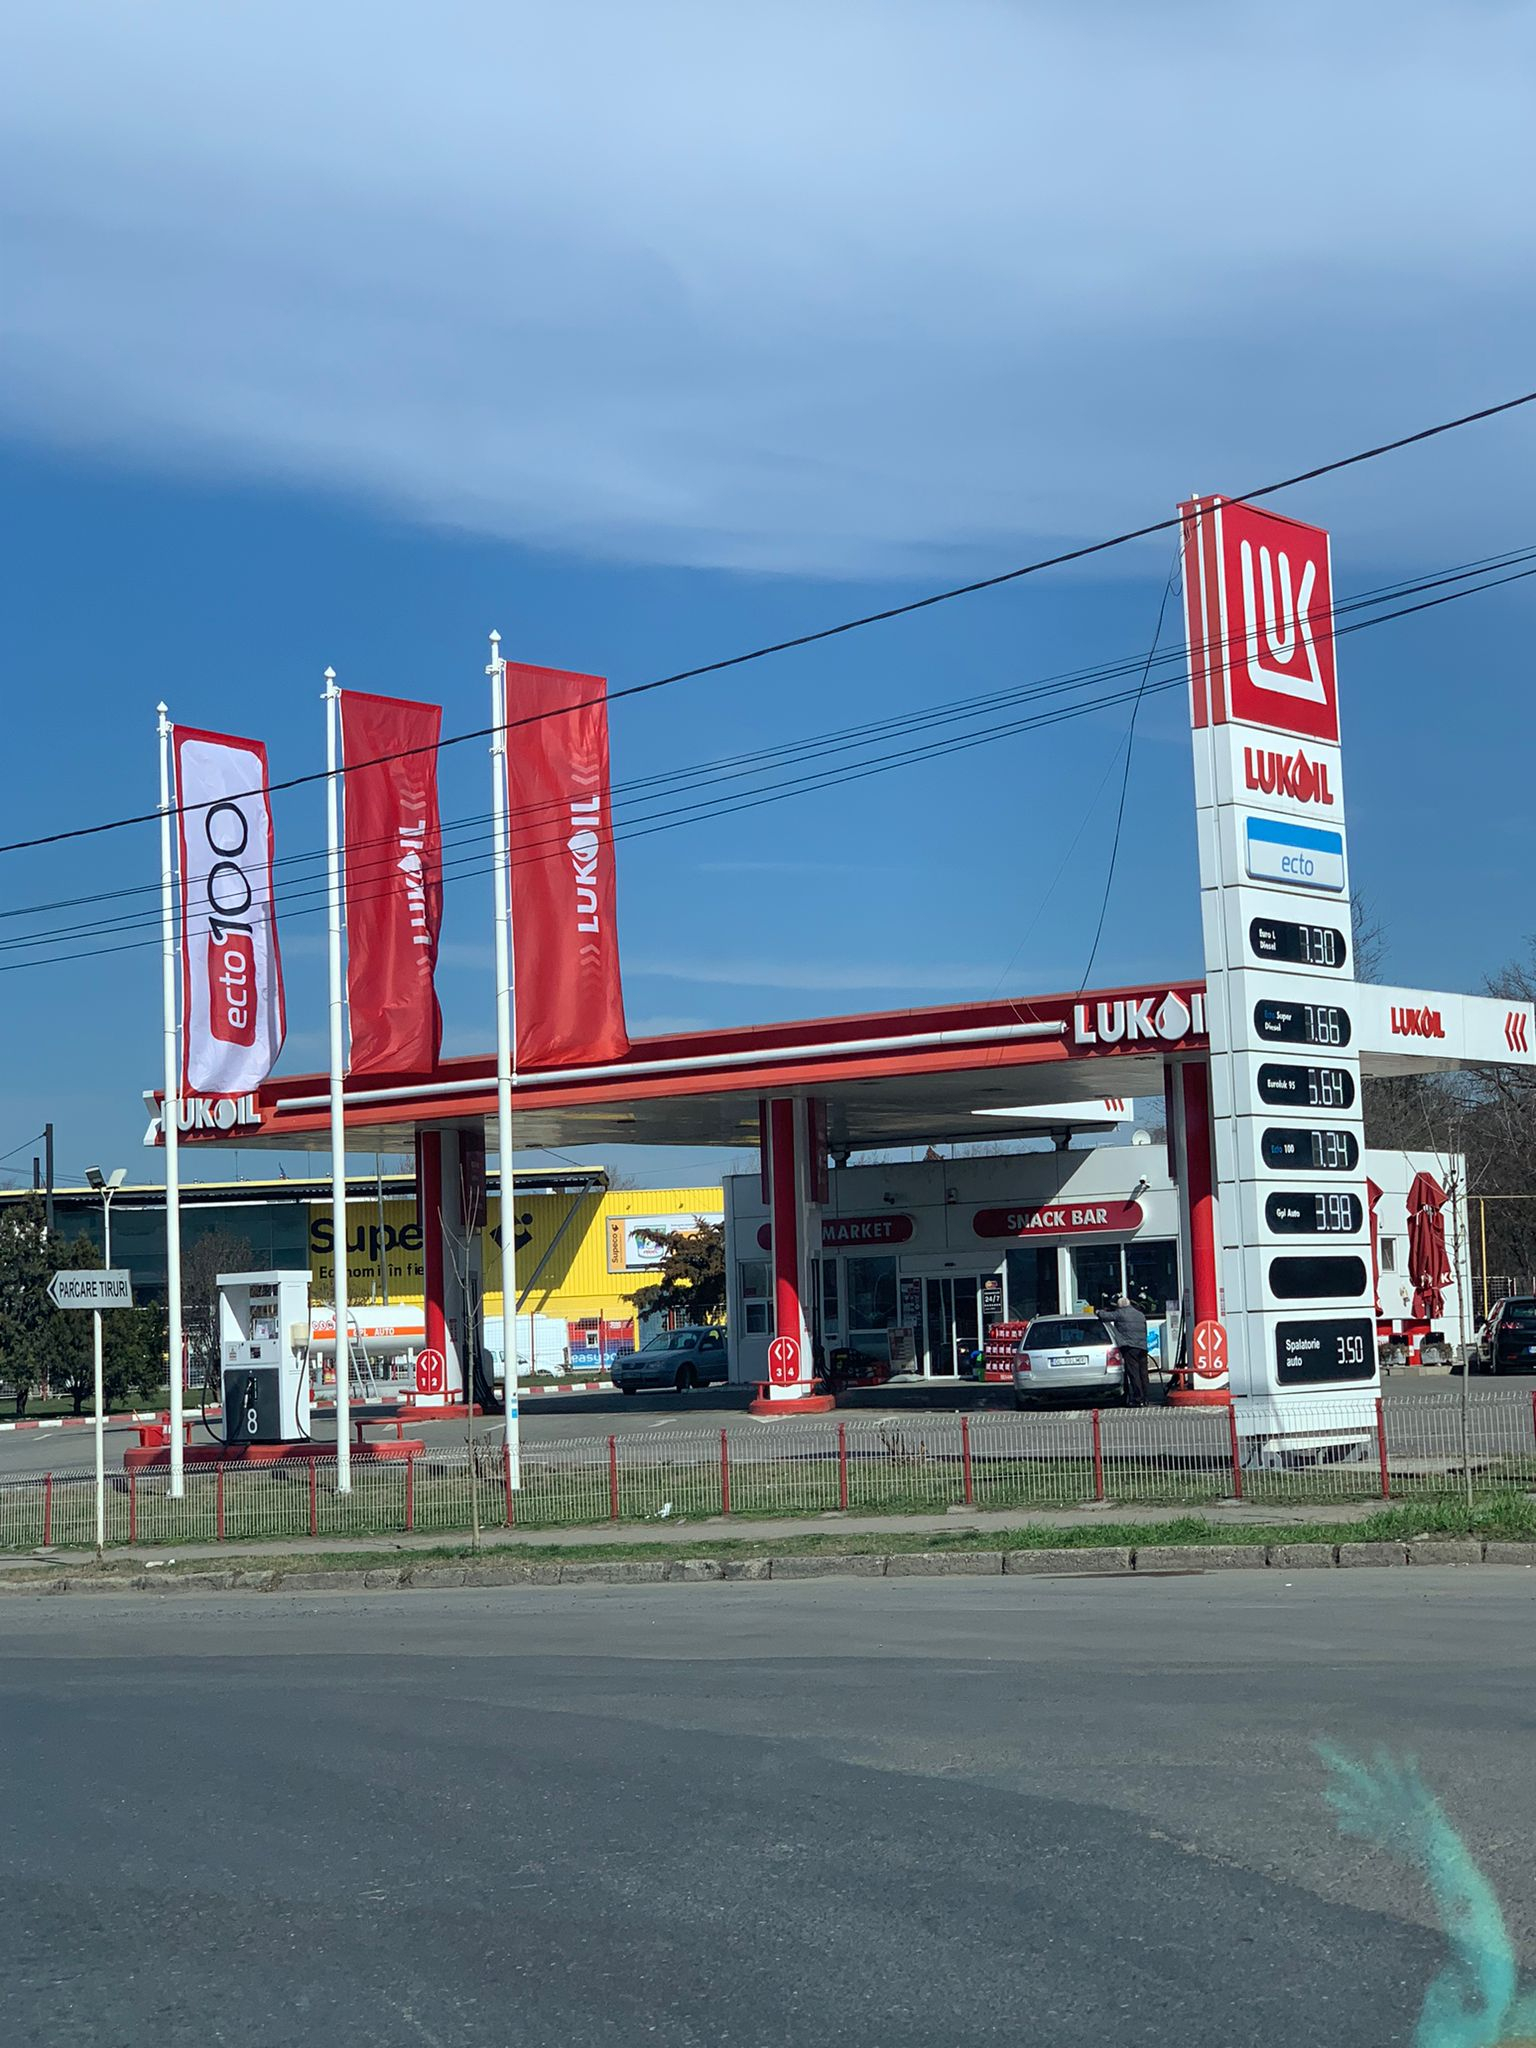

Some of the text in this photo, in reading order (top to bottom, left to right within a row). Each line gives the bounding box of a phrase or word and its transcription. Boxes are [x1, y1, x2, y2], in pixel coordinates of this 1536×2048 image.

[1244, 746, 1334, 804] LUKOIL
[566, 794, 600, 934] LUKOIL
[1281, 853, 1314, 877] ecto
[1259, 928, 1271, 938] Euro
[1299, 926, 1335, 965] 7.30
[1260, 940, 1276, 951] Diesel
[1074, 991, 1209, 1044] LUKOI
[1264, 1021, 1282, 1031] Diesel
[1276, 1011, 1292, 1022] Super
[1304, 1006, 1340, 1044] 7.66
[1390, 1005, 1445, 1039] LUKOIL
[1288, 1081, 1296, 1090] 95
[1284, 1144, 1295, 1154] 100
[1311, 1131, 1348, 1167] 7.34
[1007, 1208, 1108, 1230] SNACK BAR
[1276, 1195, 1352, 1231] Gpl Auto 3.98
[822, 1222, 892, 1240] MARKET
[59, 1281, 128, 1298] PARCARE TIRURI
[374, 1328, 395, 1336] AUTO
[1285, 1336, 1364, 1364] Spalatorie 3.50
[1286, 1356, 1303, 1367] auto
[776, 1367, 795, 1377] 3 4
[1197, 1356, 1223, 1369] 5 6
[421, 1378, 437, 1386] 1 2
[247, 1408, 258, 1434] 8
